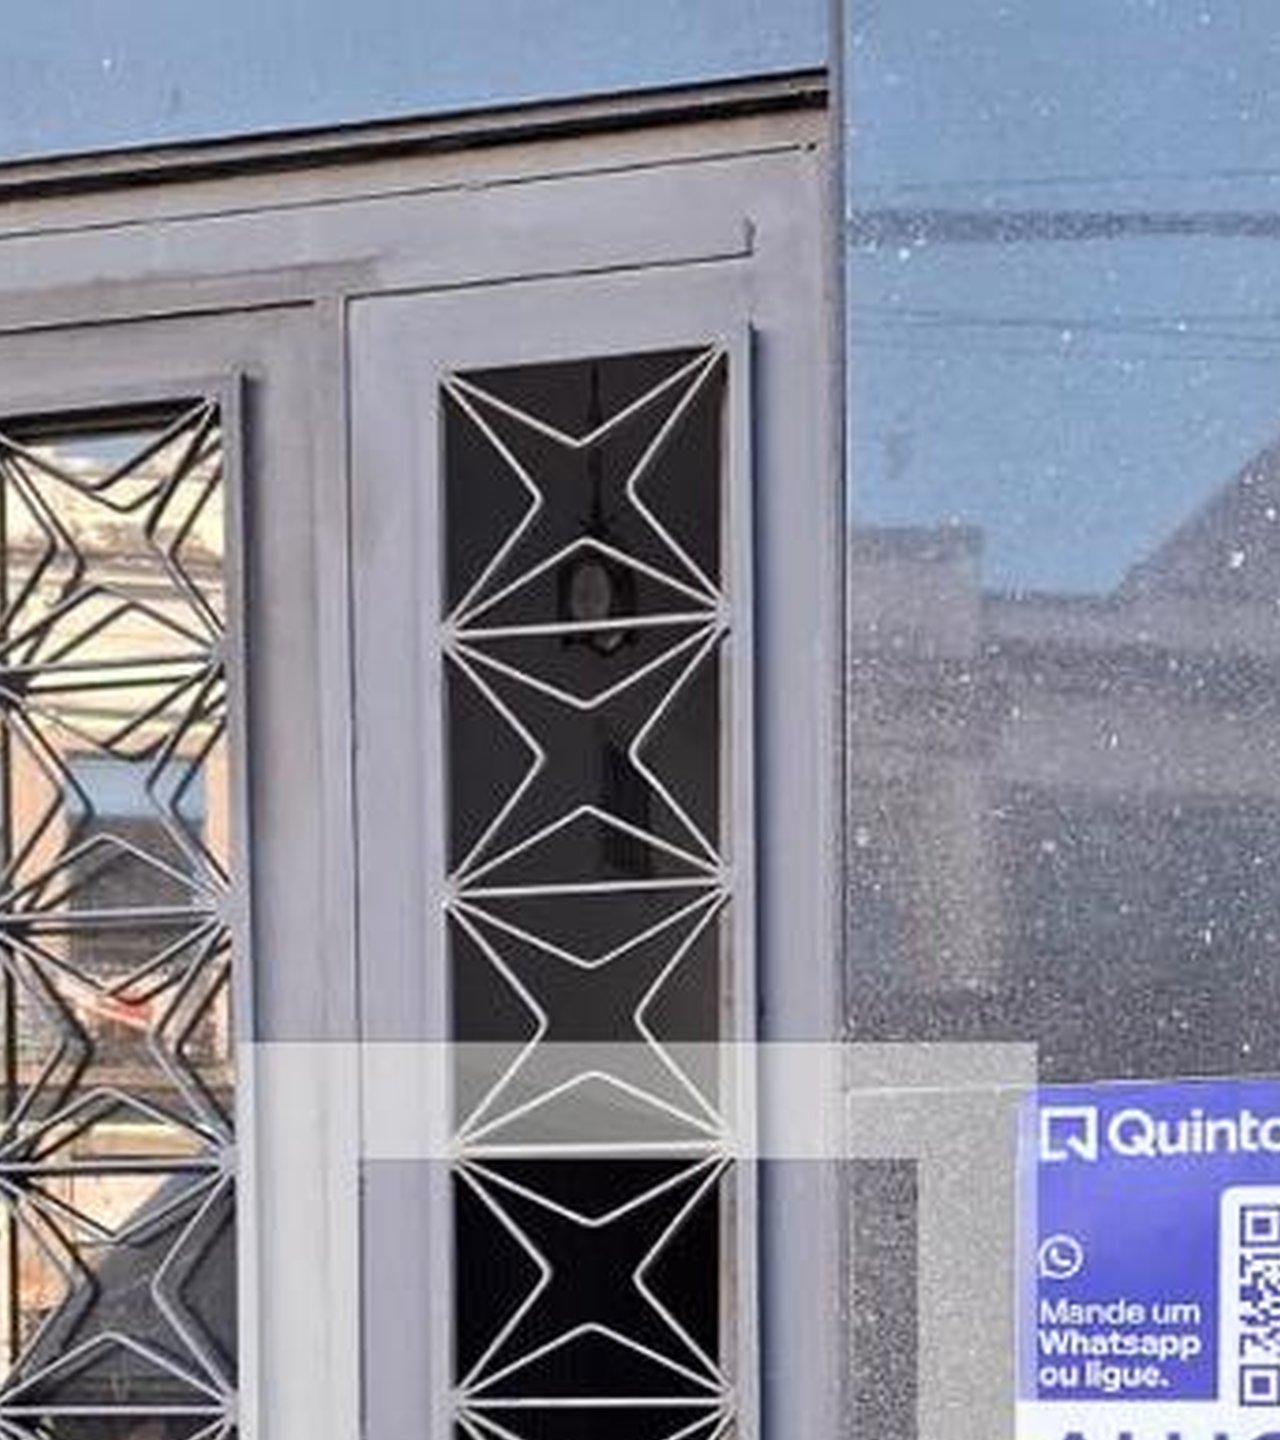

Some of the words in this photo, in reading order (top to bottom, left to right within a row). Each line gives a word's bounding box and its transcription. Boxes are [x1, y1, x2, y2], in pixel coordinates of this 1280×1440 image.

[1039, 1299, 1146, 1325] Mande
[1152, 1303, 1201, 1325] um
[1039, 1330, 1201, 1362] Whatsapp
[1039, 1366, 1078, 1388] ou
[1085, 1361, 1170, 1392] ligue.
